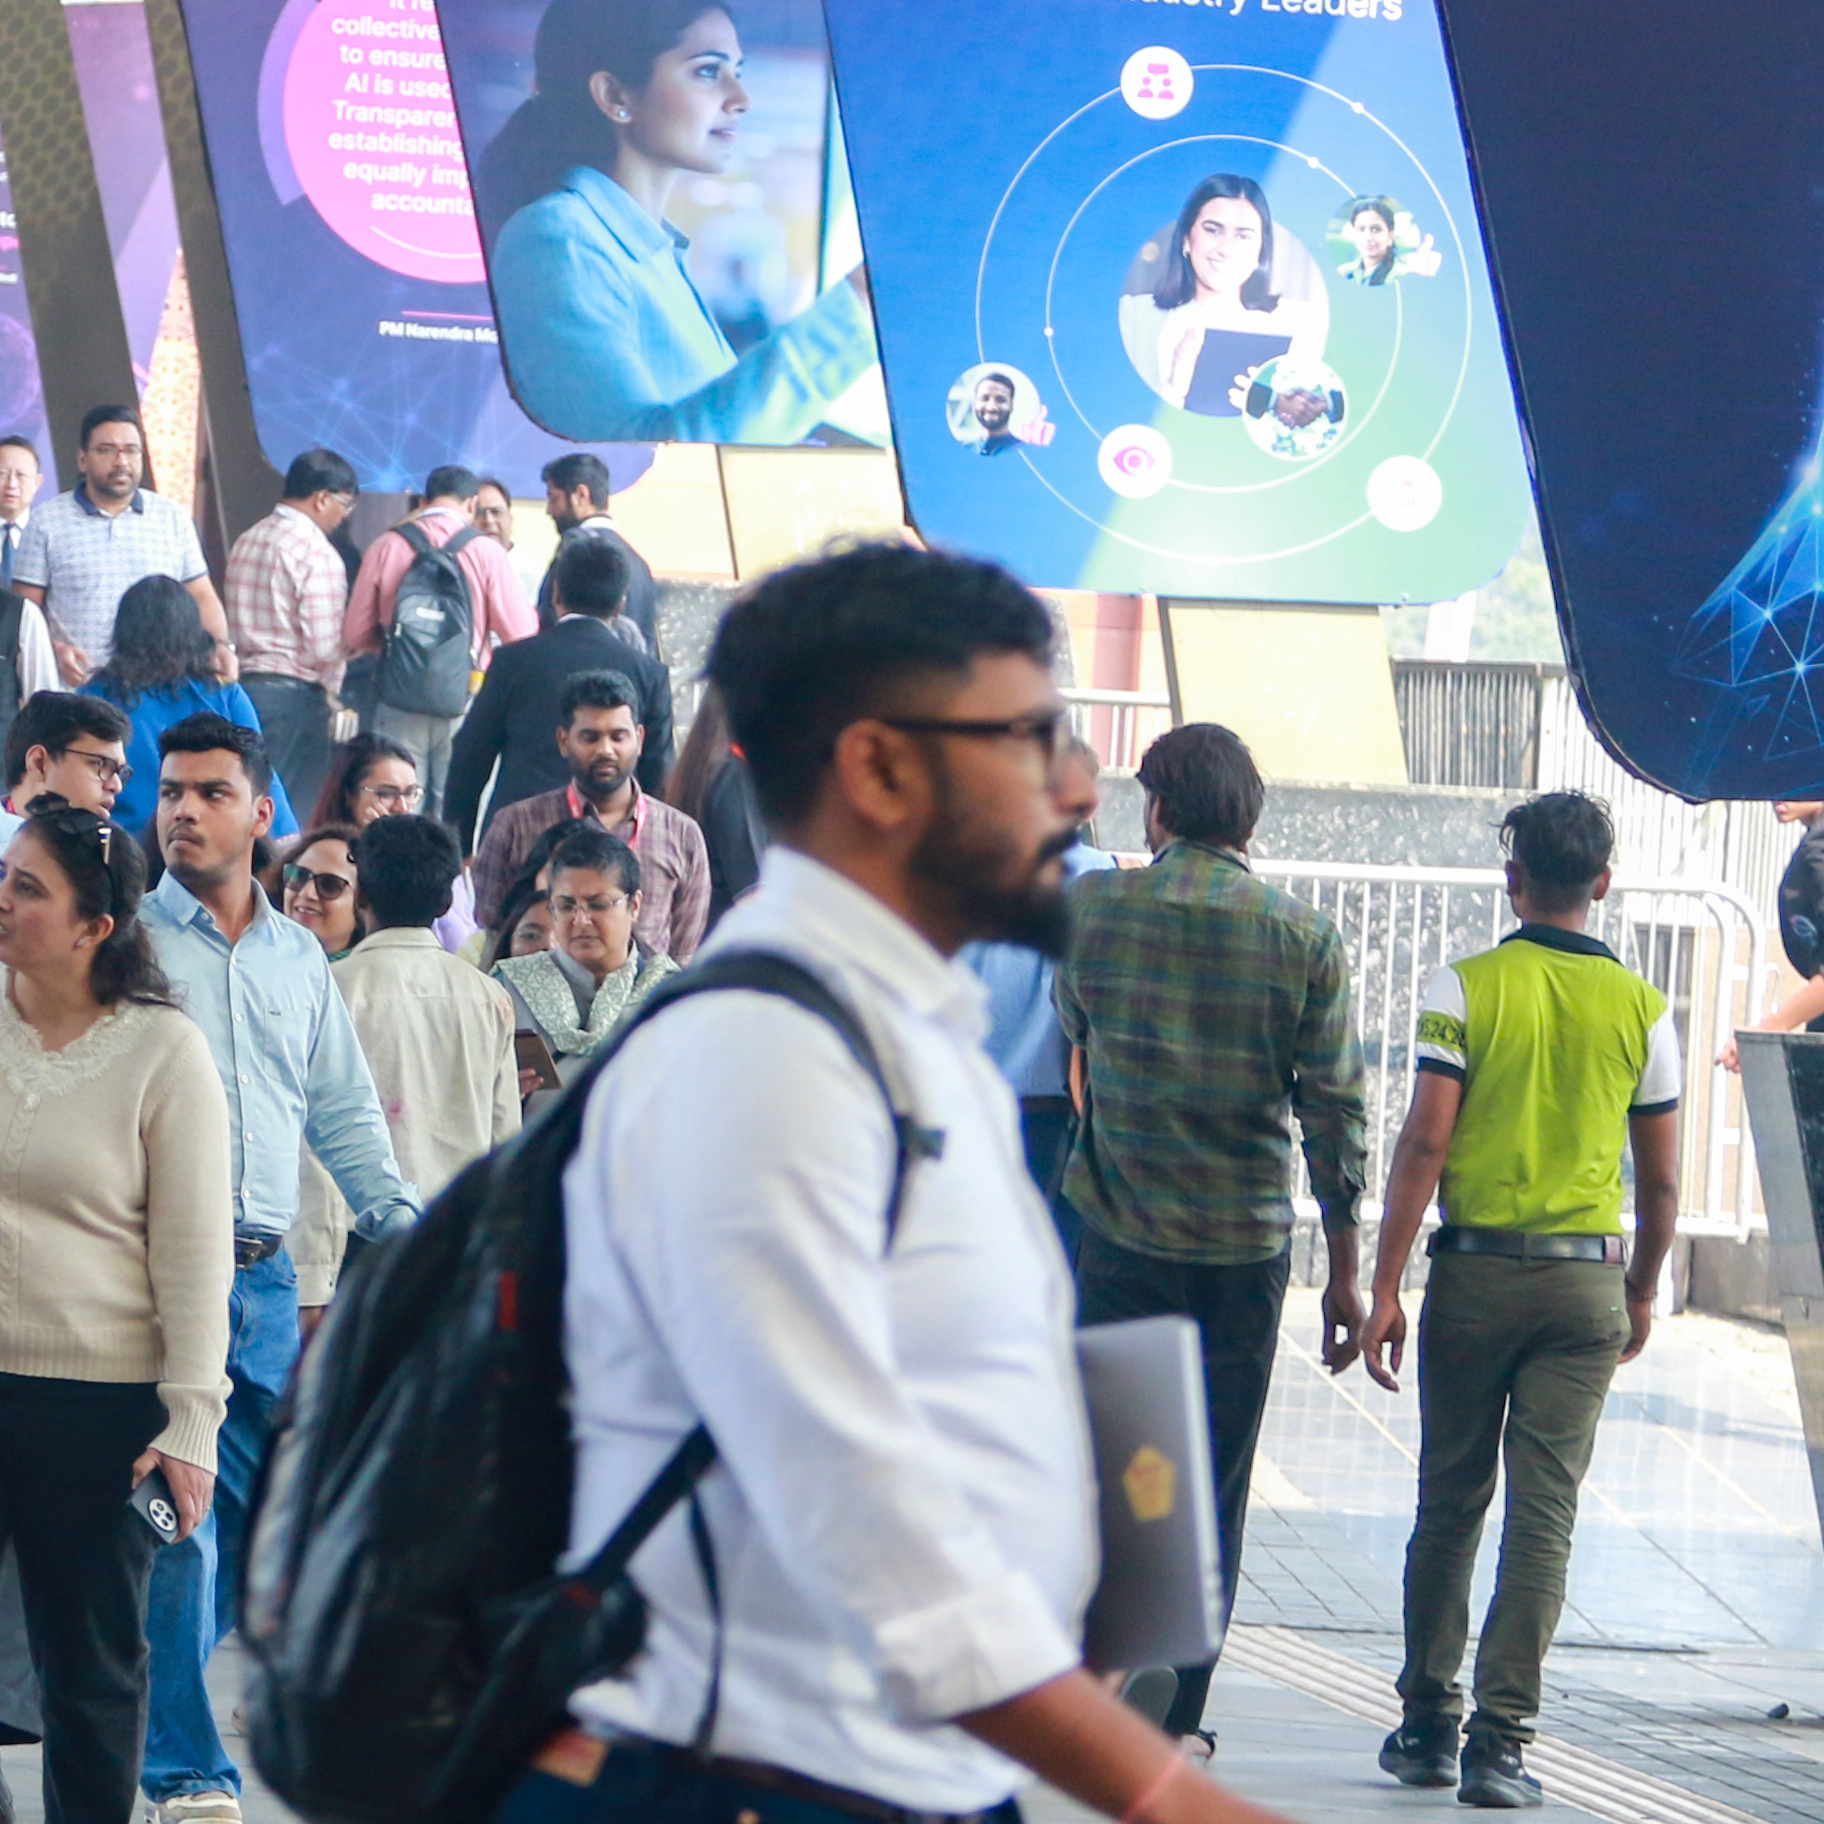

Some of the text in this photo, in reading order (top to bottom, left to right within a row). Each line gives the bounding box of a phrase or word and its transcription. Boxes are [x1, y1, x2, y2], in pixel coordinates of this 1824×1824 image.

[331, 16, 441, 41] collective
[340, 44, 447, 70] to ensure
[344, 72, 394, 95] AI is
[328, 131, 465, 163] establishing
[343, 162, 427, 188] equally
[379, 320, 404, 337] PM
[405, 322, 474, 343] Narendra
